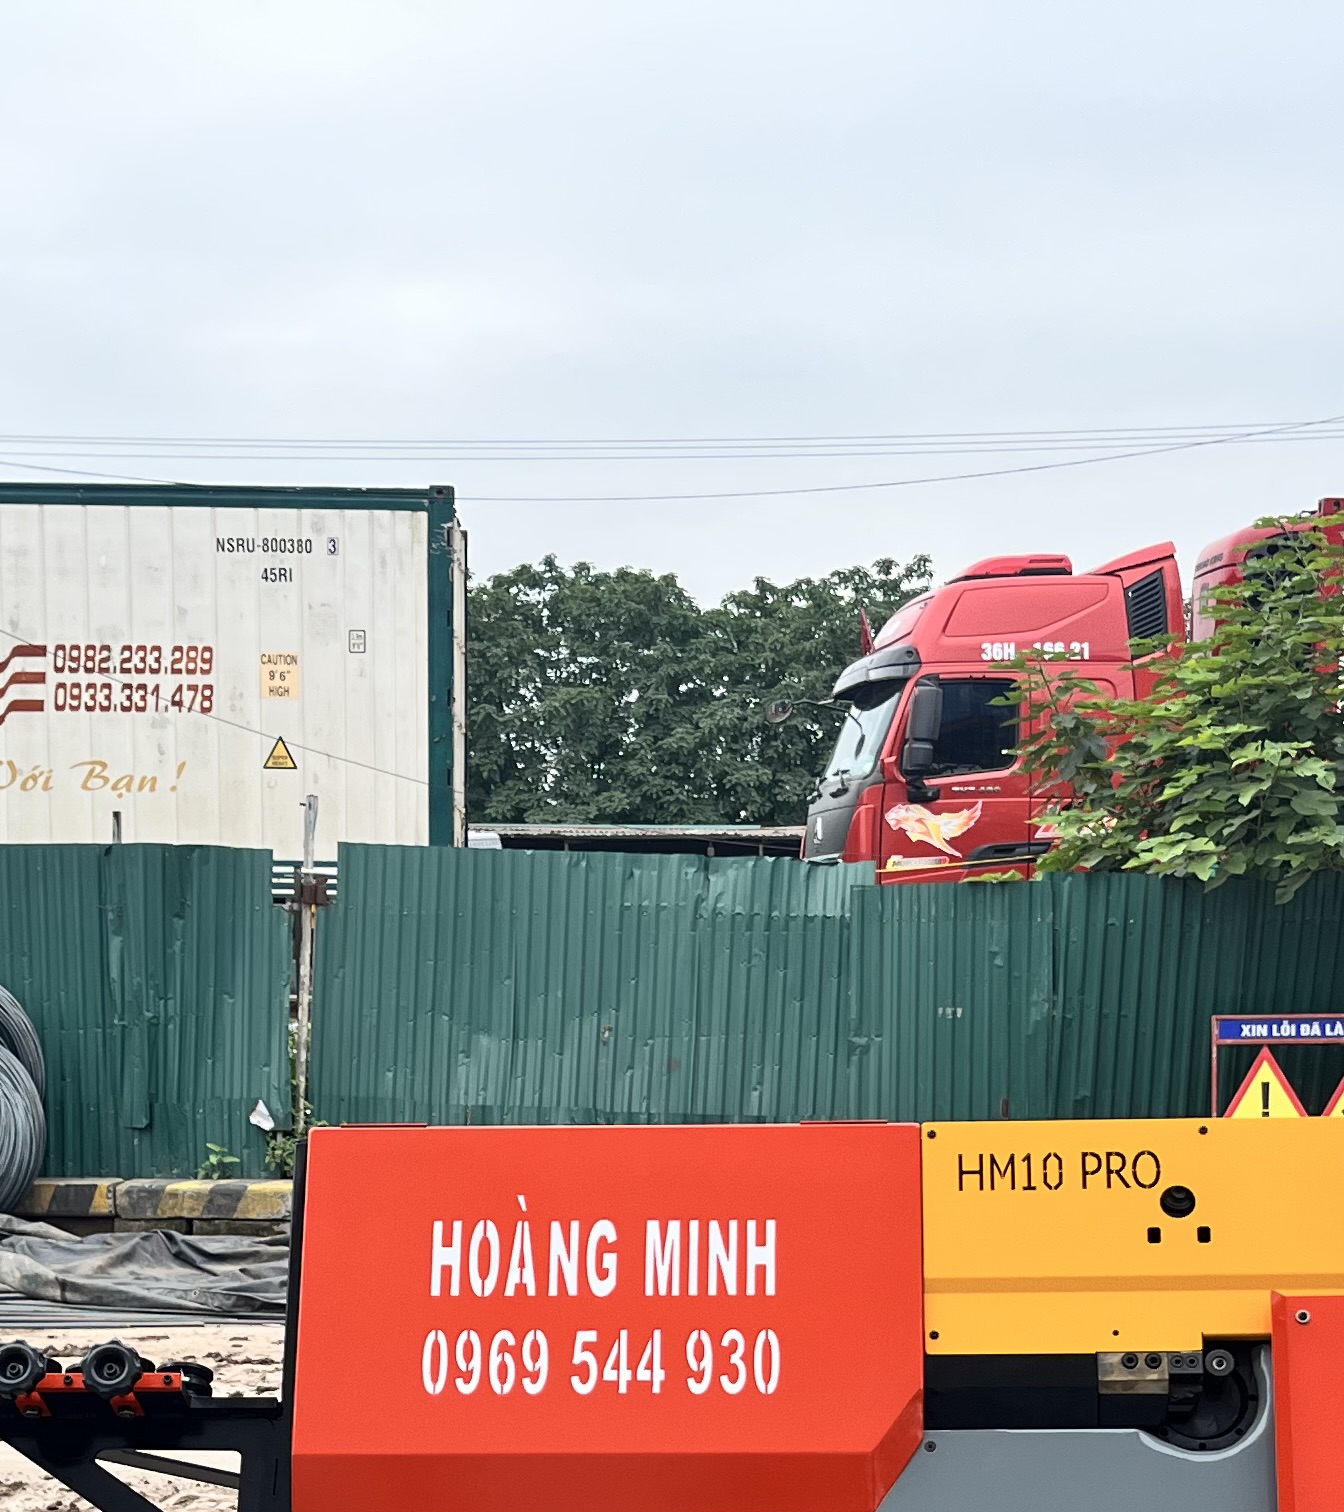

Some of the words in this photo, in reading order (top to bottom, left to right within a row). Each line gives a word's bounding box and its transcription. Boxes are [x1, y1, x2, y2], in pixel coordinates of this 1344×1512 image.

[216, 537, 313, 554] NSRU-800380
[328, 538, 337, 554] 3
[53, 643, 214, 676] 0982.233.289
[260, 653, 298, 666] CAUTION
[54, 682, 214, 714] 0933.331.478
[268, 685, 290, 697] HIGH
[1240, 1023, 1268, 1037] XIN
[957, 1151, 1064, 1192] HM10
[1080, 1149, 1162, 1190] PRO
[429, 1193, 619, 1298] HOÀNG
[644, 1218, 777, 1297] MINH
[421, 1328, 549, 1395] 0969
[569, 1328, 666, 1395] 544
[685, 1328, 781, 1395] 930
